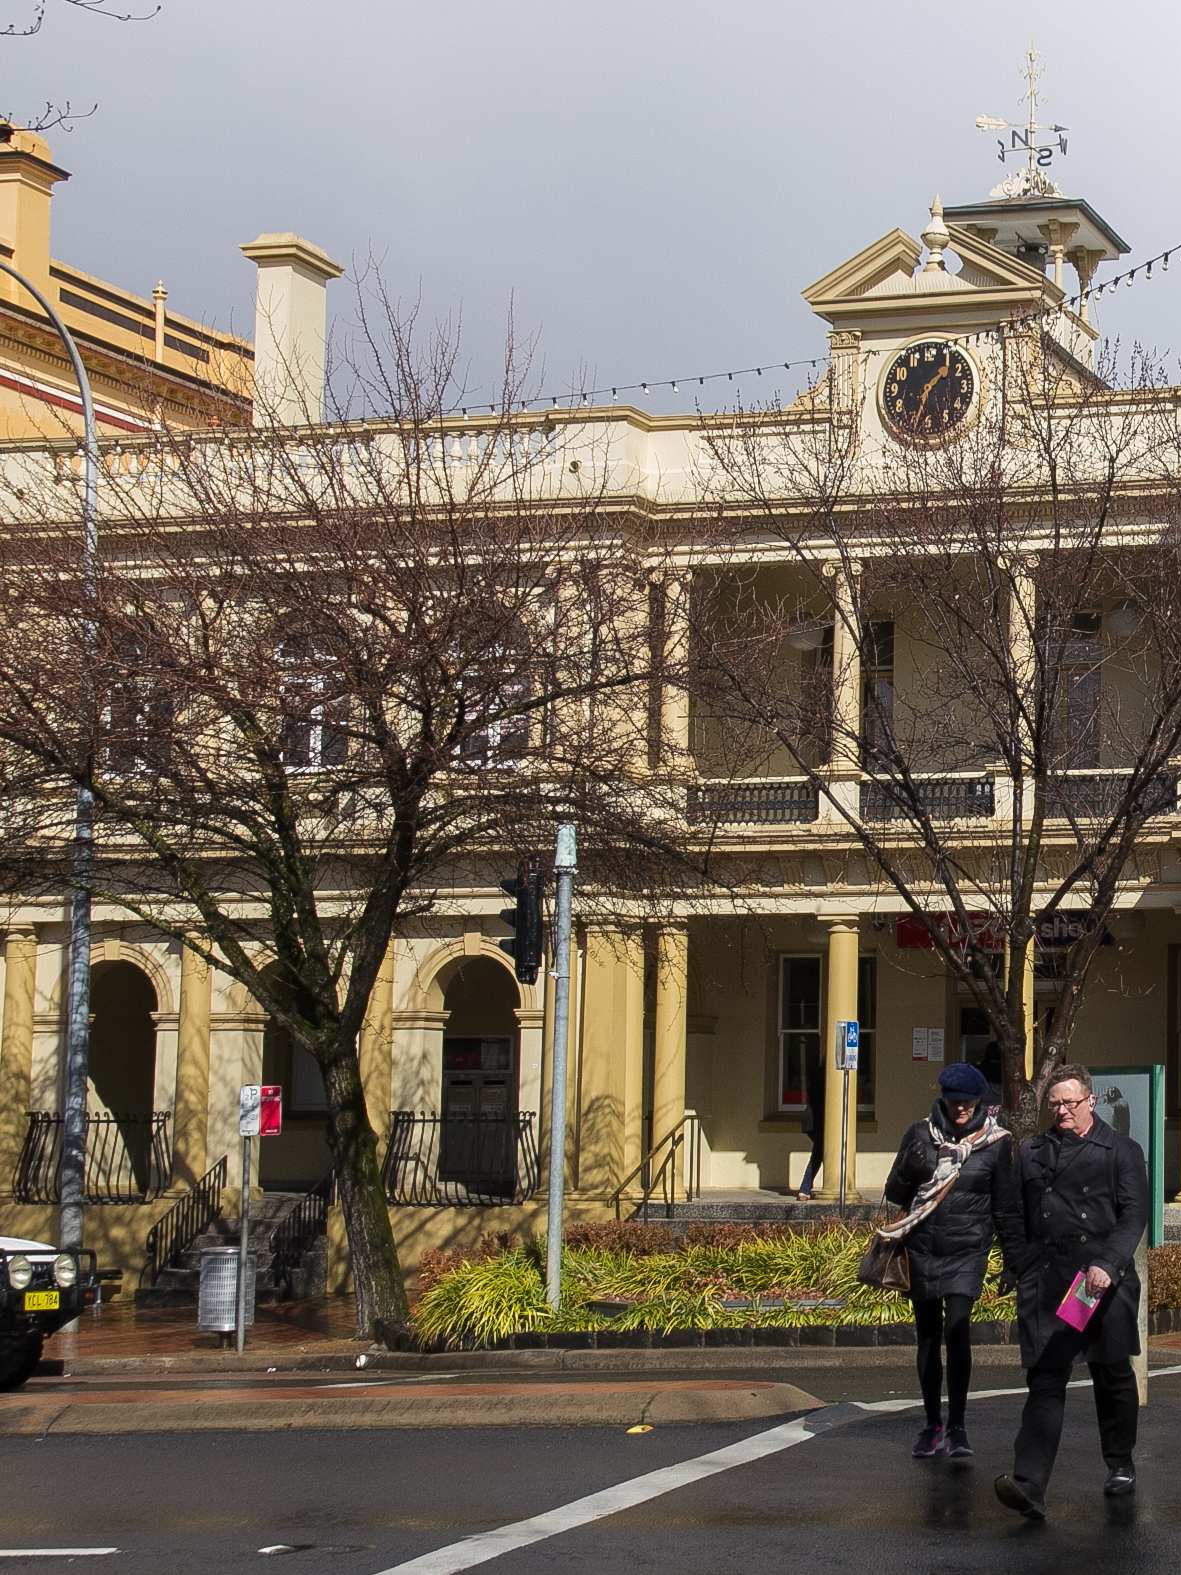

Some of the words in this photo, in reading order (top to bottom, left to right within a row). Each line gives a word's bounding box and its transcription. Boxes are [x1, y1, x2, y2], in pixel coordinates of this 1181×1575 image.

[1011, 128, 1029, 148] N
[924, 347, 937, 362] 12
[896, 367, 907, 381] 10
[955, 363, 962, 377] 2
[890, 383, 899, 397] 9
[960, 380, 968, 394] 3
[895, 399, 903, 412] 8
[953, 396, 961, 410] 4
[942, 409, 949, 423] 5
